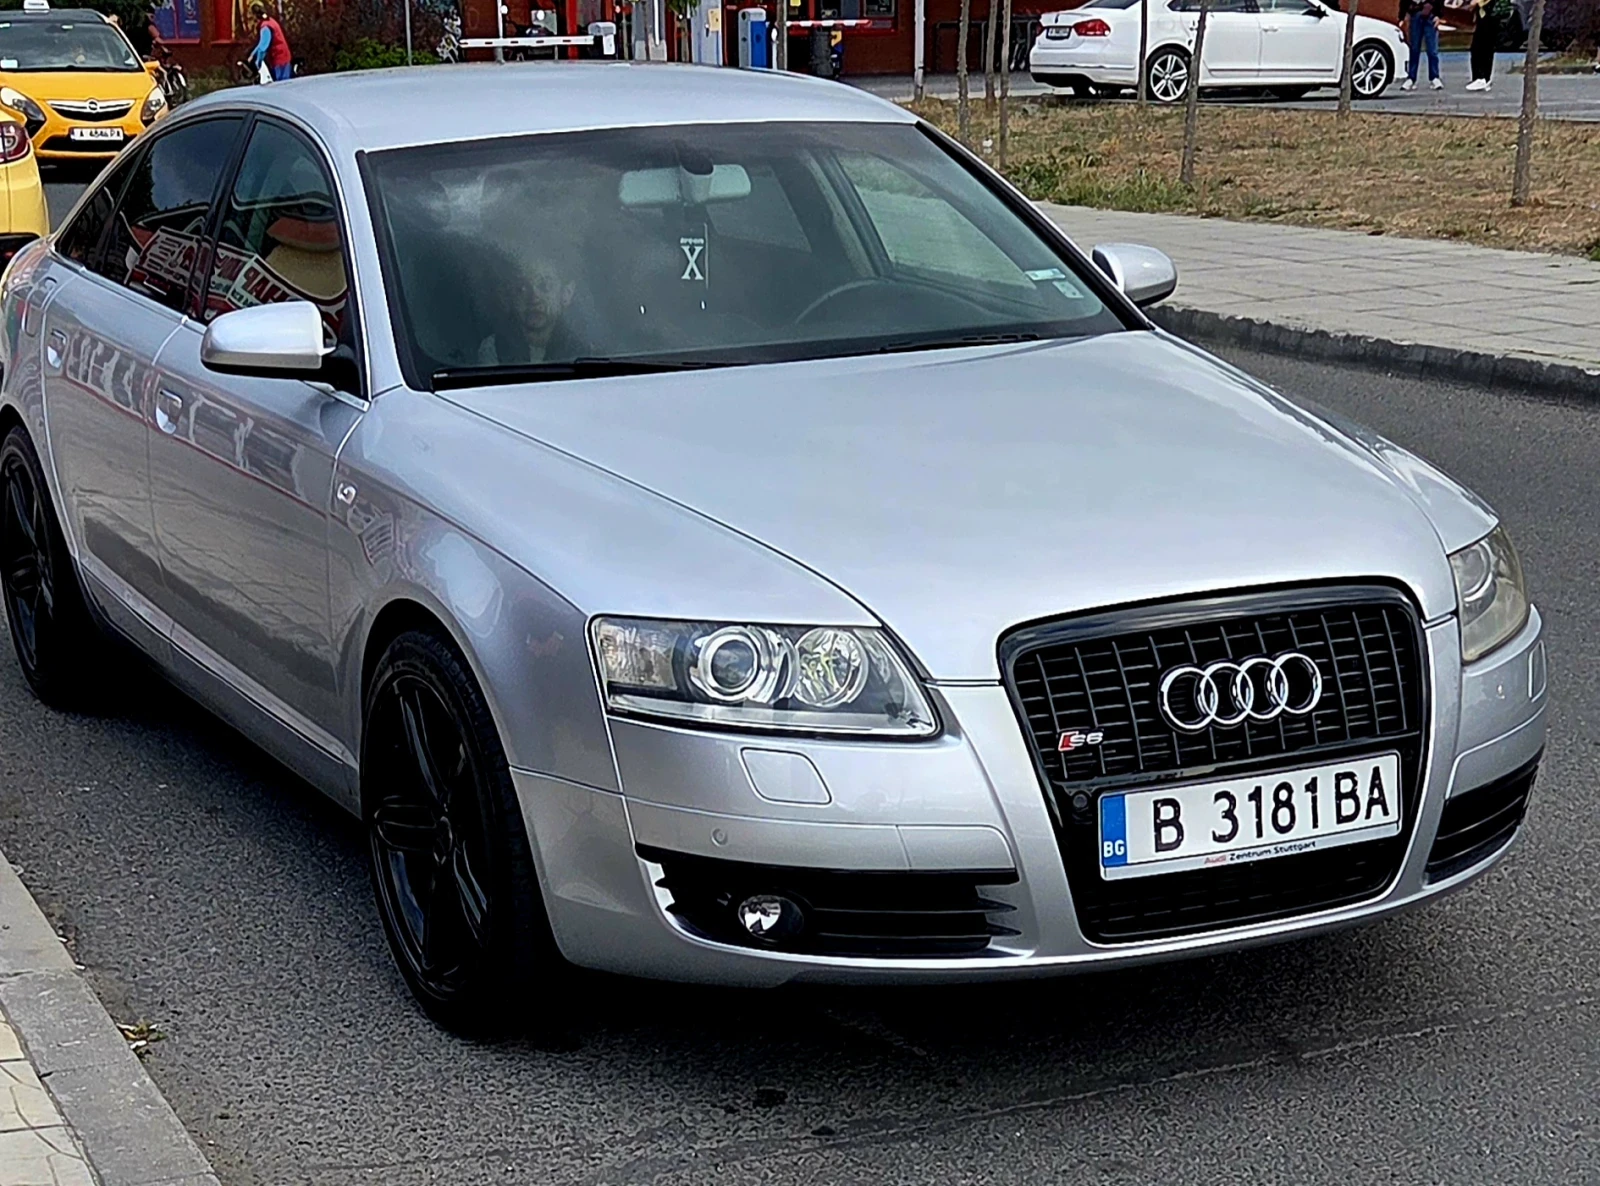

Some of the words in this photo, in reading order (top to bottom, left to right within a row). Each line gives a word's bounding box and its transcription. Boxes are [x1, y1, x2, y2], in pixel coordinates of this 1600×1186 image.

[1068, 732, 1103, 747] S6
[1153, 798, 1184, 853] B
[1212, 776, 1319, 843] 3181
[1335, 766, 1390, 825] BA
[1103, 840, 1125, 858] BG
[1204, 854, 1227, 864] Audi
[1229, 849, 1272, 861] Zentrum
[1273, 840, 1316, 855] Stuttgart
